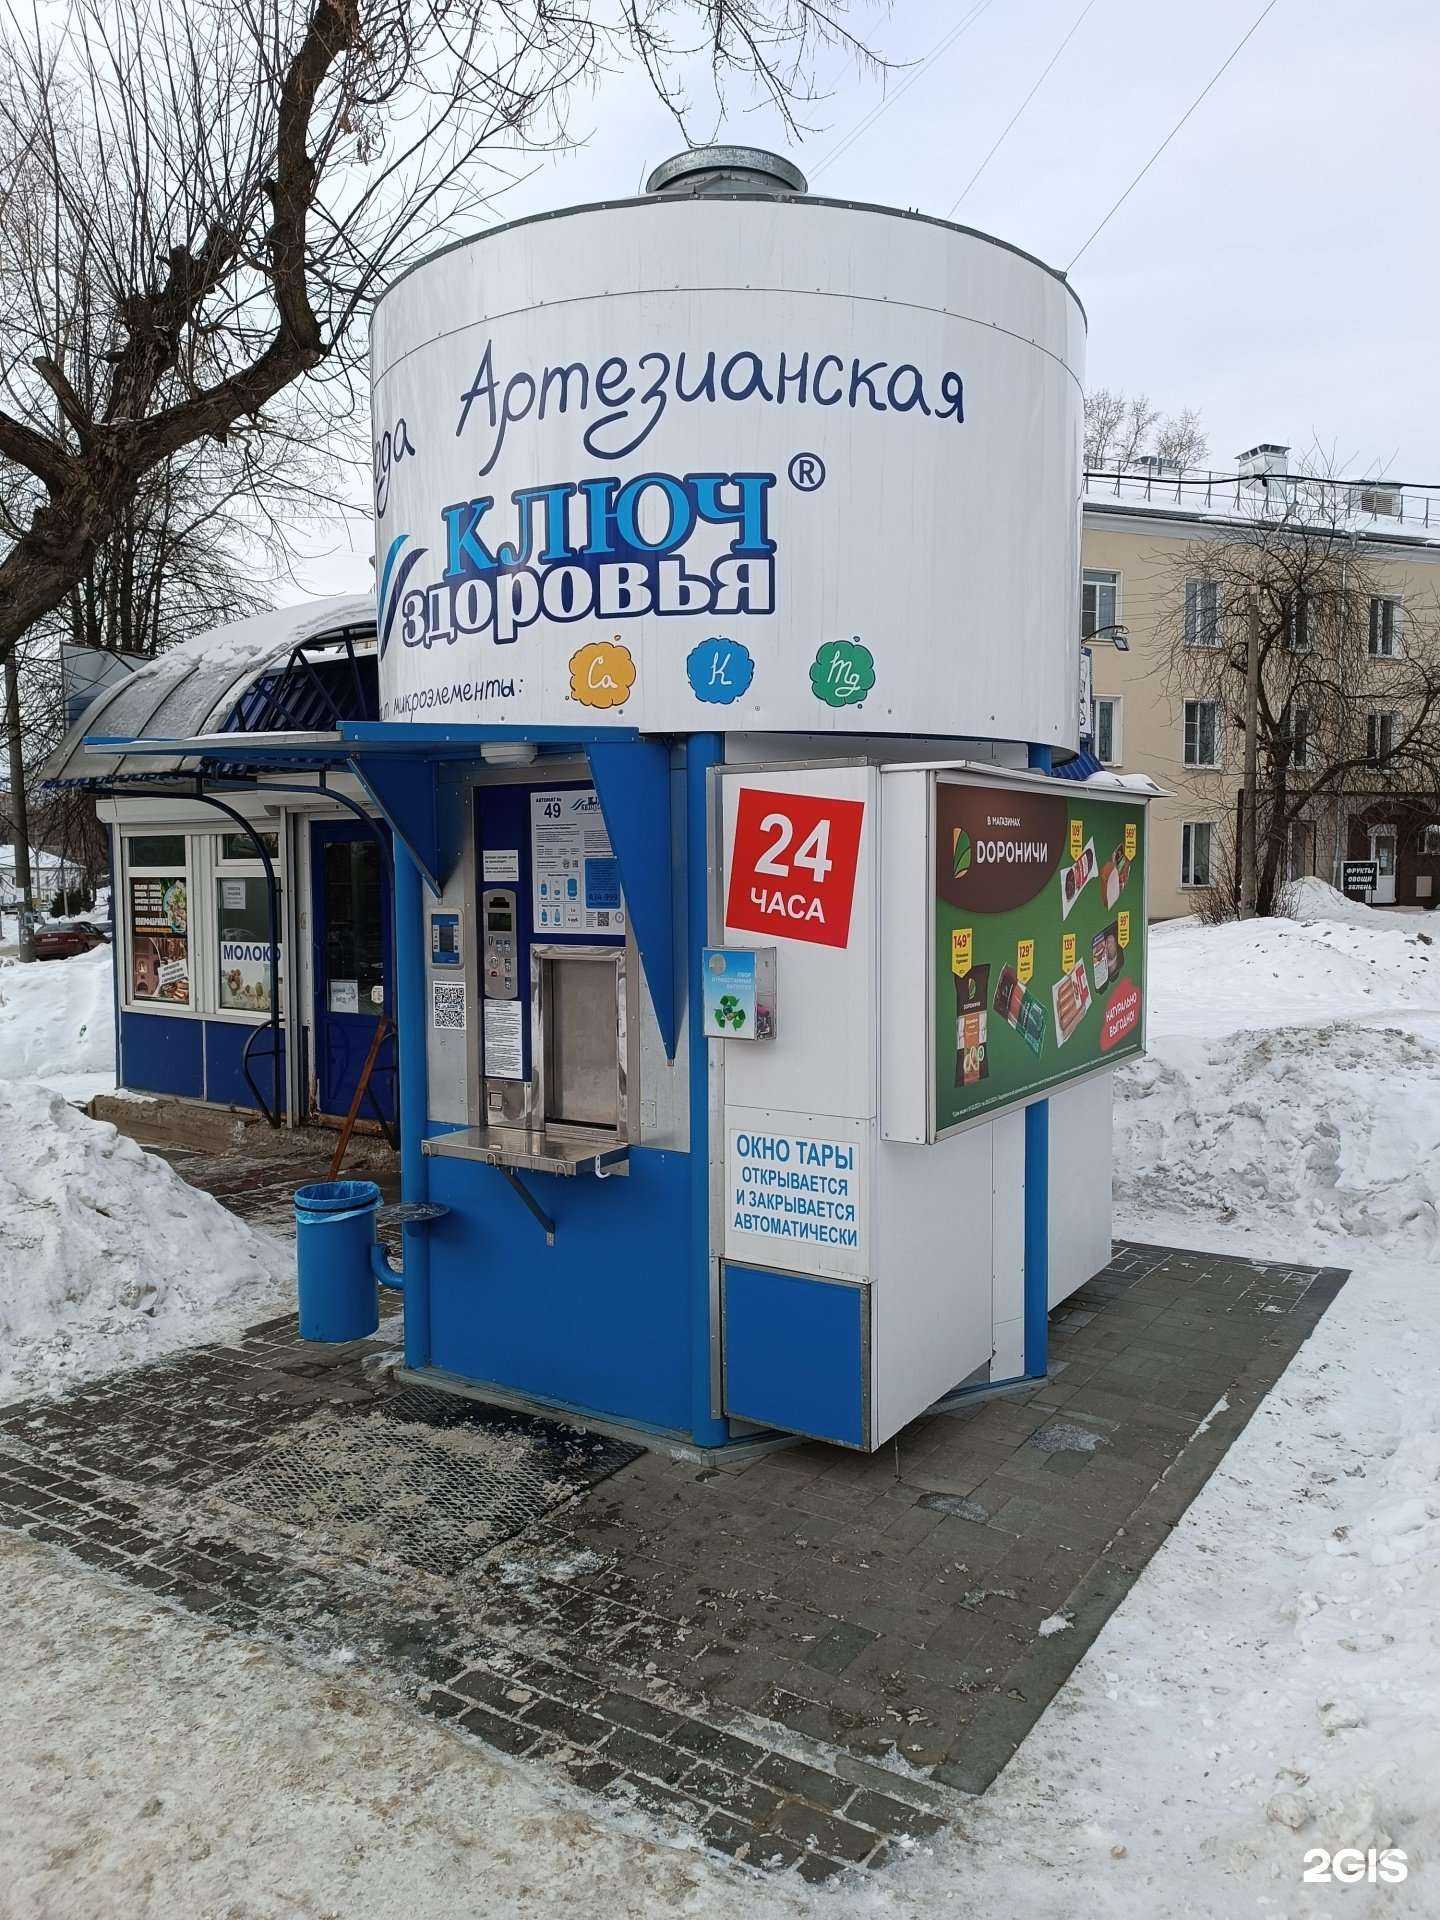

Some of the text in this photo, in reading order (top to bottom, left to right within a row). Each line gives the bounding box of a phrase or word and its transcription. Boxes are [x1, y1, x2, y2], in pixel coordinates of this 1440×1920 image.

[456, 339, 965, 477] Артезианская
[441, 472, 778, 579] КЛЮЧ
[588, 655, 619, 690] Ca
[826, 650, 861, 698] Mg
[393, 678, 525, 723] микроэлементы:
[544, 802, 561, 819] 49
[754, 813, 833, 883] 24
[750, 887, 827, 924] ЧАСА
[736, 1134, 854, 1171] ОКНО ТАРЫ
[742, 1166, 849, 1197] ОТКРЫВАЕТСЯ
[736, 1189, 856, 1222] И ЗАКРЫВАЕТСЯ
[734, 1212, 858, 1247] АВТОМАТИЧЕСКИ
